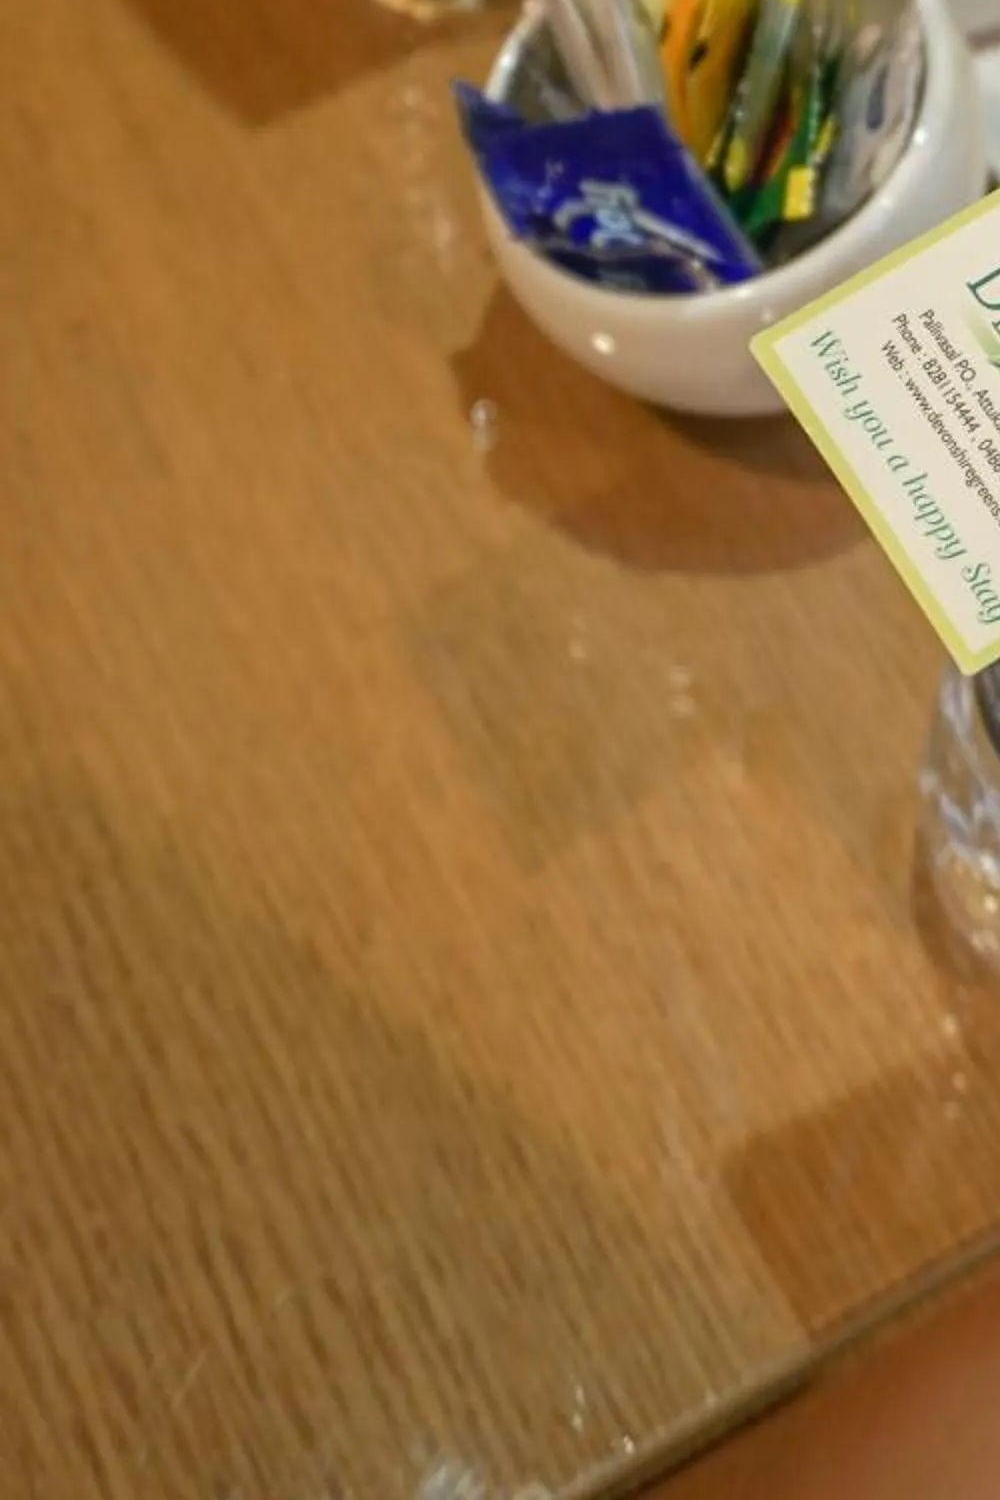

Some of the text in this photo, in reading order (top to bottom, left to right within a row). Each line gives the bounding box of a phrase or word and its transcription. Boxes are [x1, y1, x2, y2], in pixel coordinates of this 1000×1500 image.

[810, 330, 862, 396] Wish
[844, 400, 894, 449] you
[886, 455, 909, 472] a
[902, 472, 967, 560] happy
